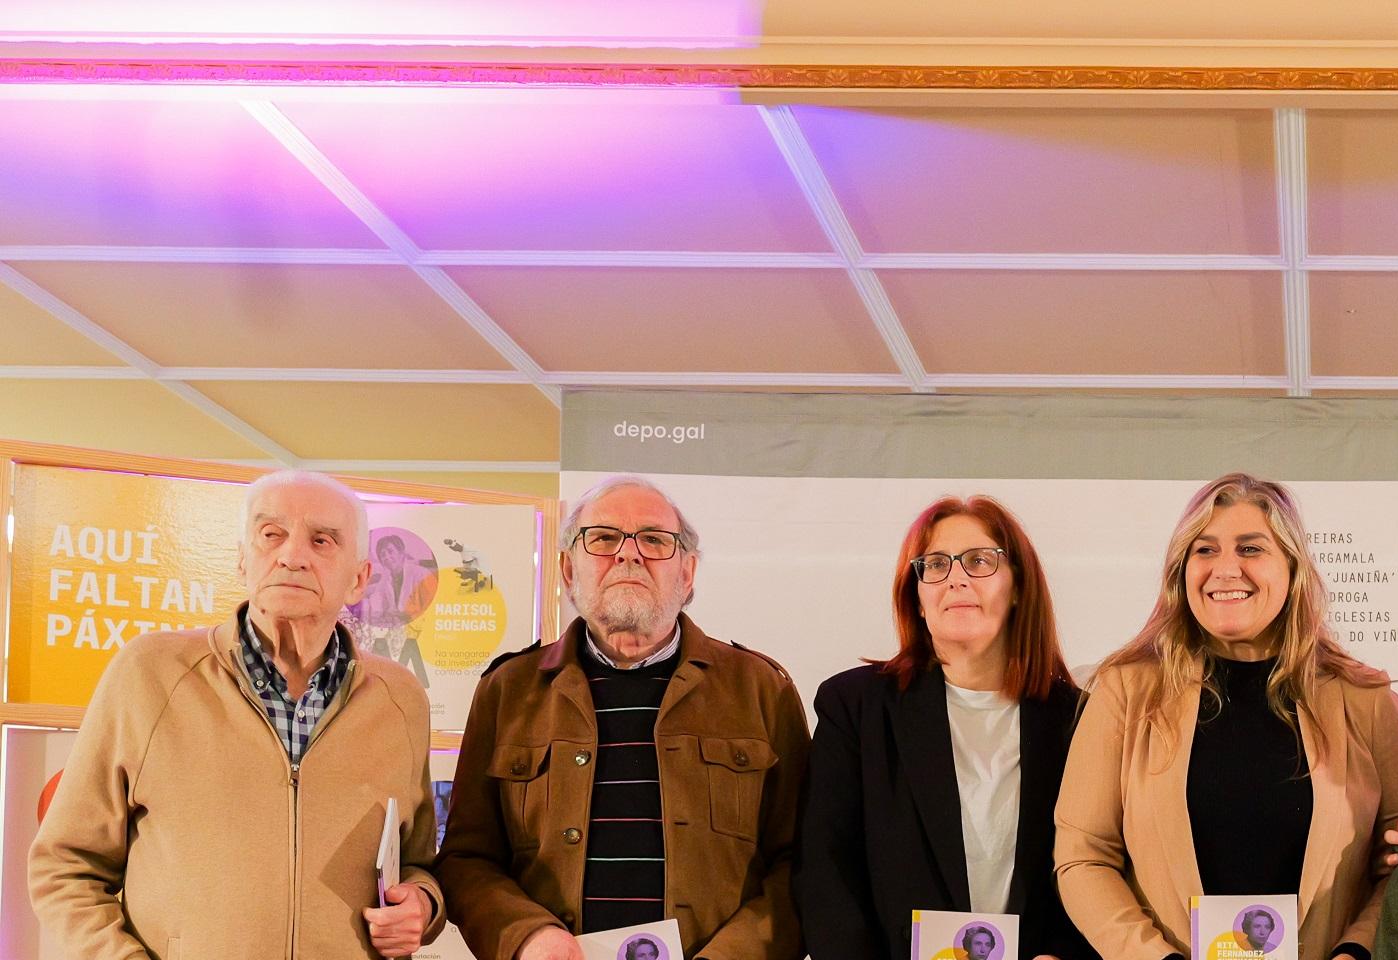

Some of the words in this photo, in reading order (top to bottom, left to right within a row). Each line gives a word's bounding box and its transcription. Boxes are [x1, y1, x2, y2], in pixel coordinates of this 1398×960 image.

[613, 420, 705, 444] depo.gal
[50, 523, 161, 565] AQUÍ
[1305, 532, 1353, 544] REIRAS
[1311, 551, 1375, 564] ARGAMALA
[49, 567, 217, 614] FALTAN
[434, 603, 497, 616] MARISOL
[434, 619, 497, 632] SOENGAS
[1349, 631, 1364, 642] DO
